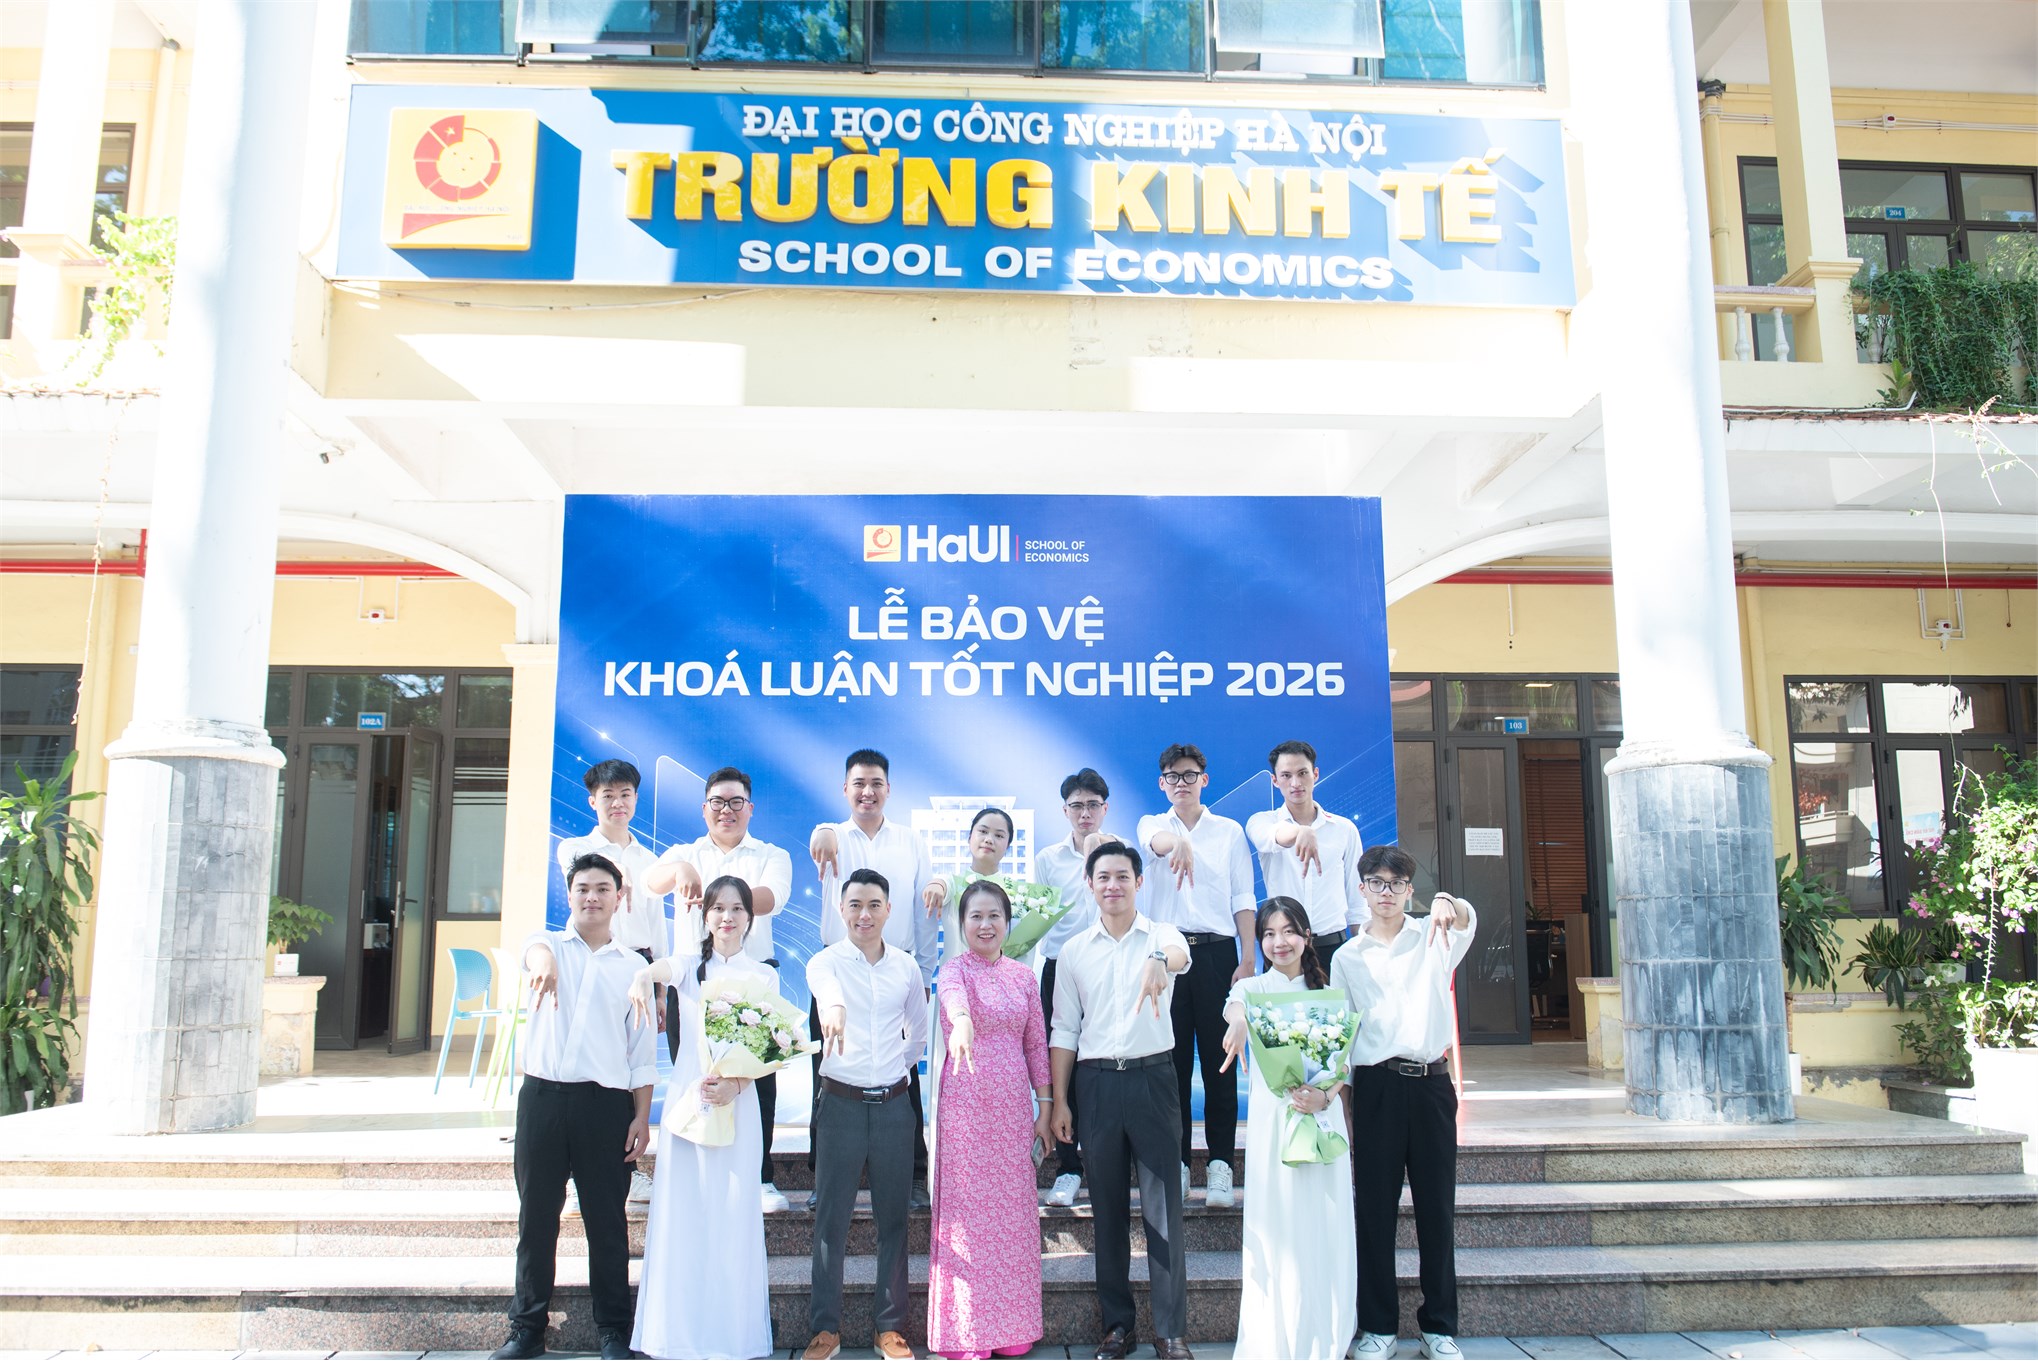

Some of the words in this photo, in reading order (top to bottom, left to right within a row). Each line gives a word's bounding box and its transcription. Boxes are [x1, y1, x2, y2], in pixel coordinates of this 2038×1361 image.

[742, 105, 819, 144] ĐẠI
[830, 107, 923, 145] HỌC
[933, 101, 1053, 144] CÔNG
[1063, 108, 1224, 155] NGHIỆP
[1236, 112, 1300, 152] HÀ
[1312, 114, 1387, 162] NỘI
[613, 136, 1054, 229] TRƯỜNG
[1090, 160, 1350, 239] KINH
[1378, 147, 1509, 244] TẾ
[738, 240, 962, 277] SCHOOL
[984, 246, 1053, 279] OF
[1074, 248, 1395, 290] ECONOMICS
[908, 524, 1010, 563] HaUI
[1024, 540, 1069, 551] SCHOOL
[1072, 540, 1086, 551] OF
[1024, 552, 1090, 563] ECONOMICS
[848, 587, 909, 641] LỄ
[921, 594, 1028, 641] BẢO
[1036, 595, 1105, 648] VỆ
[603, 649, 751, 697] KHOÁ
[760, 650, 899, 703] LUẬN
[909, 643, 1015, 697] TỐT
[1026, 650, 1215, 704] NGHIỆP
[1225, 661, 1346, 697] 2026
